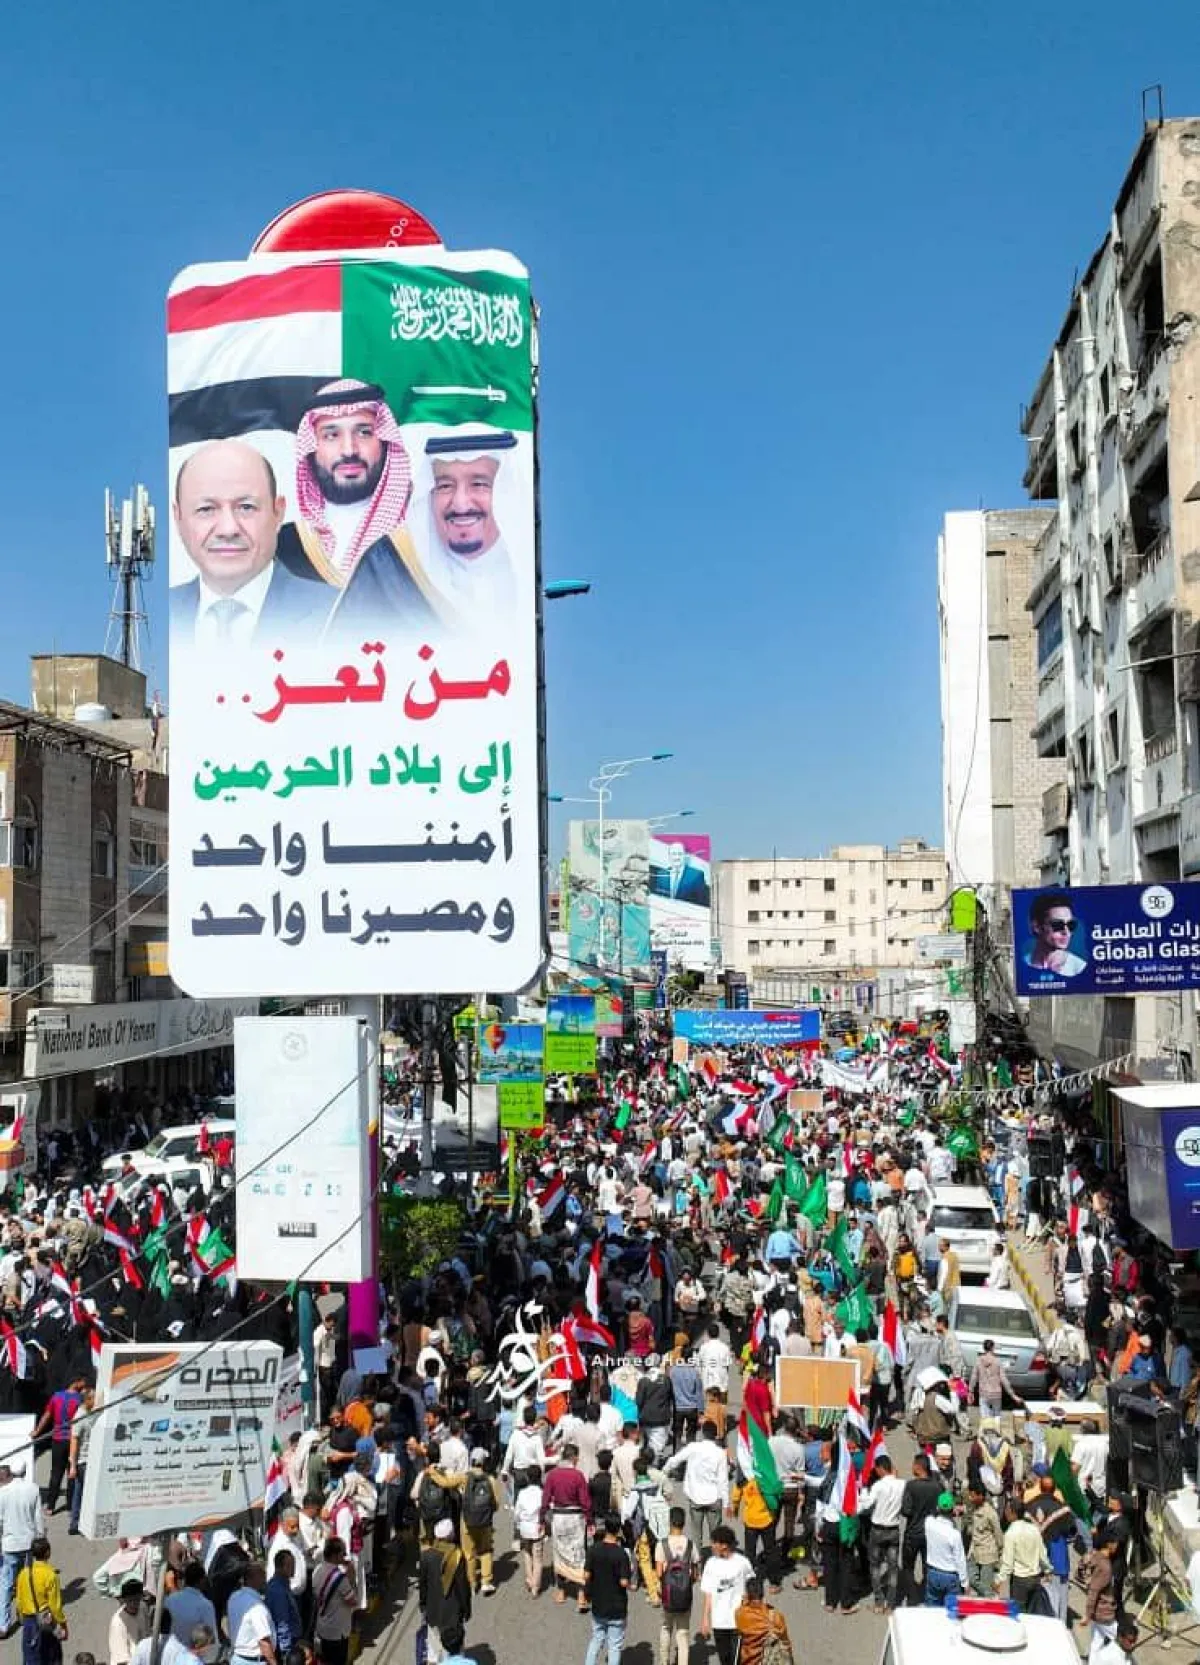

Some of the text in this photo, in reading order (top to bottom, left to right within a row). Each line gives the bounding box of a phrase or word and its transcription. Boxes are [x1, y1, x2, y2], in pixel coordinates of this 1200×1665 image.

[404, 644, 511, 720] من
[193, 741, 512, 801] إلى بلاد الحرمين
[192, 803, 513, 877] أمننا واحد
[191, 888, 515, 946] ومصيرنا واحد
[1091, 921, 1162, 944] العالمية
[1092, 942, 1154, 961] Global
[41, 1024, 87, 1055] National
[87, 1022, 111, 1050] Bank
[114, 1019, 127, 1046] Of
[128, 1017, 157, 1045] Yemen
